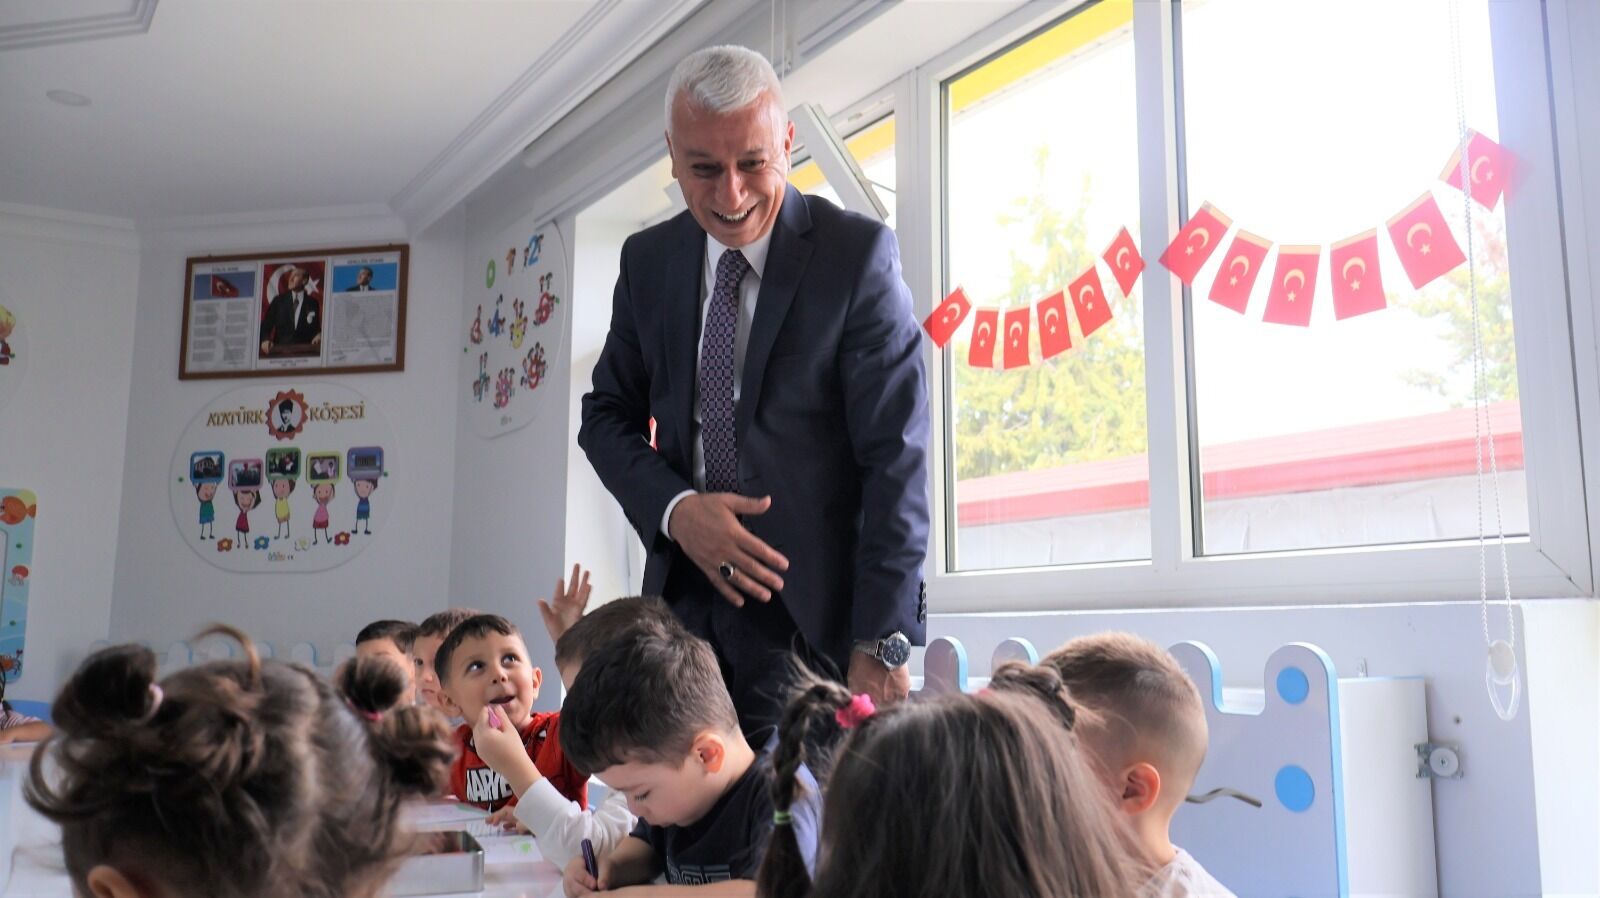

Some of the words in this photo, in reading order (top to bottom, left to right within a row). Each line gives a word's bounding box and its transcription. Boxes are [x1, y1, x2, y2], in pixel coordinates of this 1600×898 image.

[528, 234, 540, 266] 2
[207, 406, 264, 428] ATATÜRK
[309, 401, 366, 423] KÖŞESİ
